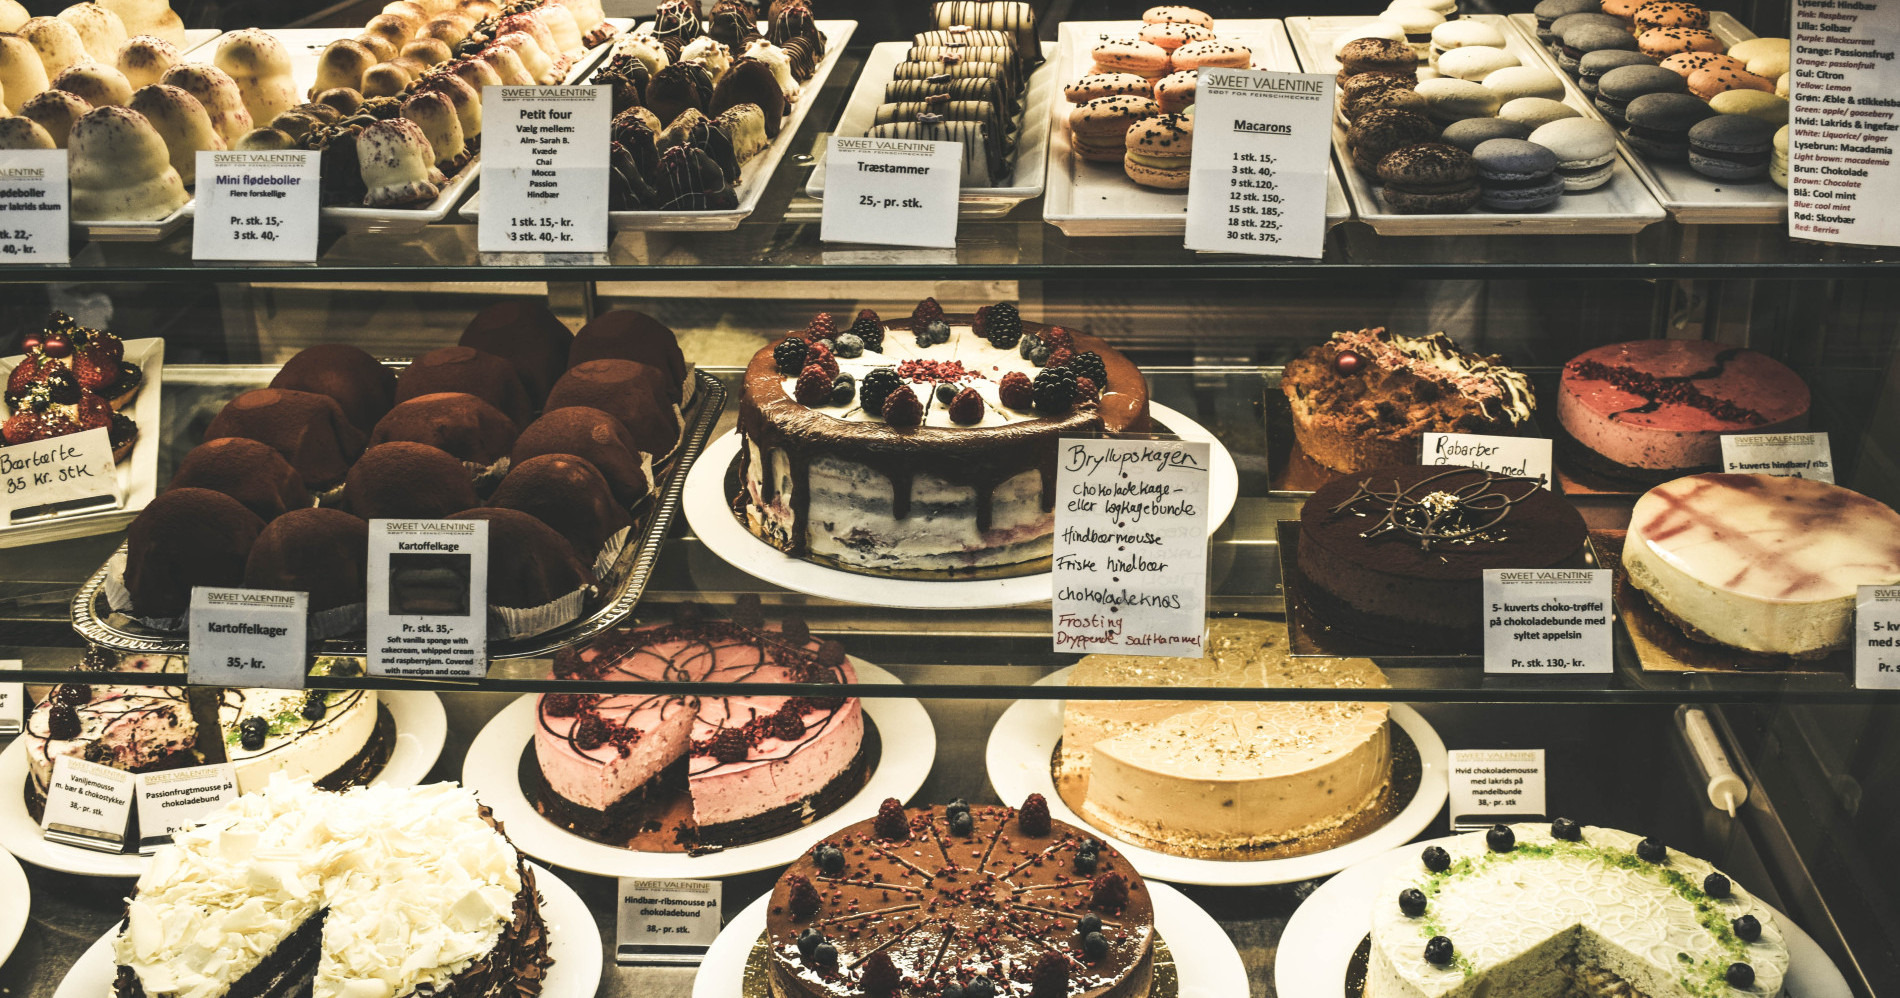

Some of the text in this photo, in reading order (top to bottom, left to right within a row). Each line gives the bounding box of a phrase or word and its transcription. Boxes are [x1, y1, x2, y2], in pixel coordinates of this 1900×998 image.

[1818, 12, 1857, 22] Raspberry
[1797, 22, 1852, 33] Lilla: Solbær
[1797, 34, 1875, 46] Purple: Blackcurrant
[1797, 46, 1895, 60] Orange: Passionsfrugt
[1796, 58, 1875, 70] Orange: passionfruit
[1796, 69, 1844, 79] Gul: Citron
[1208, 74, 1323, 93] SWEET VALENTINE
[1796, 82, 1824, 90] Yellow:
[501, 89, 597, 97] SWEET VALENTINE
[1795, 93, 1845, 103] Grøn: Æble
[520, 109, 572, 119] Petit four
[1822, 108, 1849, 116] apple/
[1850, 109, 1894, 119] gooseberry
[516, 125, 574, 134] Vælg mellem:
[1234, 119, 1292, 133] Macarons
[1795, 117, 1899, 131] Hvid: Lakrids & ingefær
[1795, 129, 1888, 142] White: Liquorice/ ginger
[837, 140, 935, 151] SWEET VALENTINE
[1794, 141, 1893, 154] Lysebrun: Macadamia
[858, 161, 929, 174] Træstammer
[1794, 165, 1868, 177] Brun: Chokolade
[216, 175, 301, 186] Mini flødeboller
[1794, 177, 1862, 188] Brown: Chocolate
[250, 190, 286, 198] forskellige
[1230, 192, 1285, 204] 12 stk. 150,-
[1794, 189, 1856, 200] Blå: Cool mint
[9, 202, 61, 211] lakrids skum
[860, 195, 922, 208] 25,- pr. stk.
[1815, 202, 1831, 210] cool
[1832, 203, 1850, 211] mint
[1229, 205, 1283, 217] 15 stk. 185,-
[231, 216, 283, 227] Pr. stk. 15,-
[1228, 218, 1282, 230] 18 stk. 225,-
[1794, 212, 1855, 224] Rød: Skovbær
[1436, 436, 1499, 460] Rabarber
[1065, 445, 1197, 476] Bryllupskagen
[1740, 461, 1770, 469] kuverts
[1502, 459, 1526, 476] med
[8, 477, 26, 493] 35
[1068, 499, 1097, 512] eller
[399, 542, 459, 552] Kartoffelkage
[1056, 553, 1097, 572] Friske
[1504, 603, 1539, 612] kuverts
[1541, 603, 1603, 612] choko-trøffel
[1059, 613, 1122, 635] Frosting
[1490, 616, 1605, 628] på chokoladebunde med
[208, 622, 287, 637] Kartoffelkager
[403, 624, 453, 634] Pr. stk. 35,-
[1514, 631, 1582, 641] syltet appelsin
[1869, 637, 1892, 647] med
[421, 647, 451, 655] whipped
[227, 657, 265, 669] 35,- kr.
[1512, 658, 1585, 668] Pr. stk. 130,- kr.
[402, 668, 433, 676] marcipan
[70, 774, 115, 792] Vaniljemousse
[1514, 777, 1523, 785] på
[65, 784, 77, 792] bær
[85, 790, 125, 806] chokostykker
[146, 782, 232, 799] Passionfrugtmousse på
[162, 795, 220, 808] chokoladebund
[625, 896, 717, 908] Hindbær-ribsmousse på
[640, 908, 700, 917] chokoladebund
